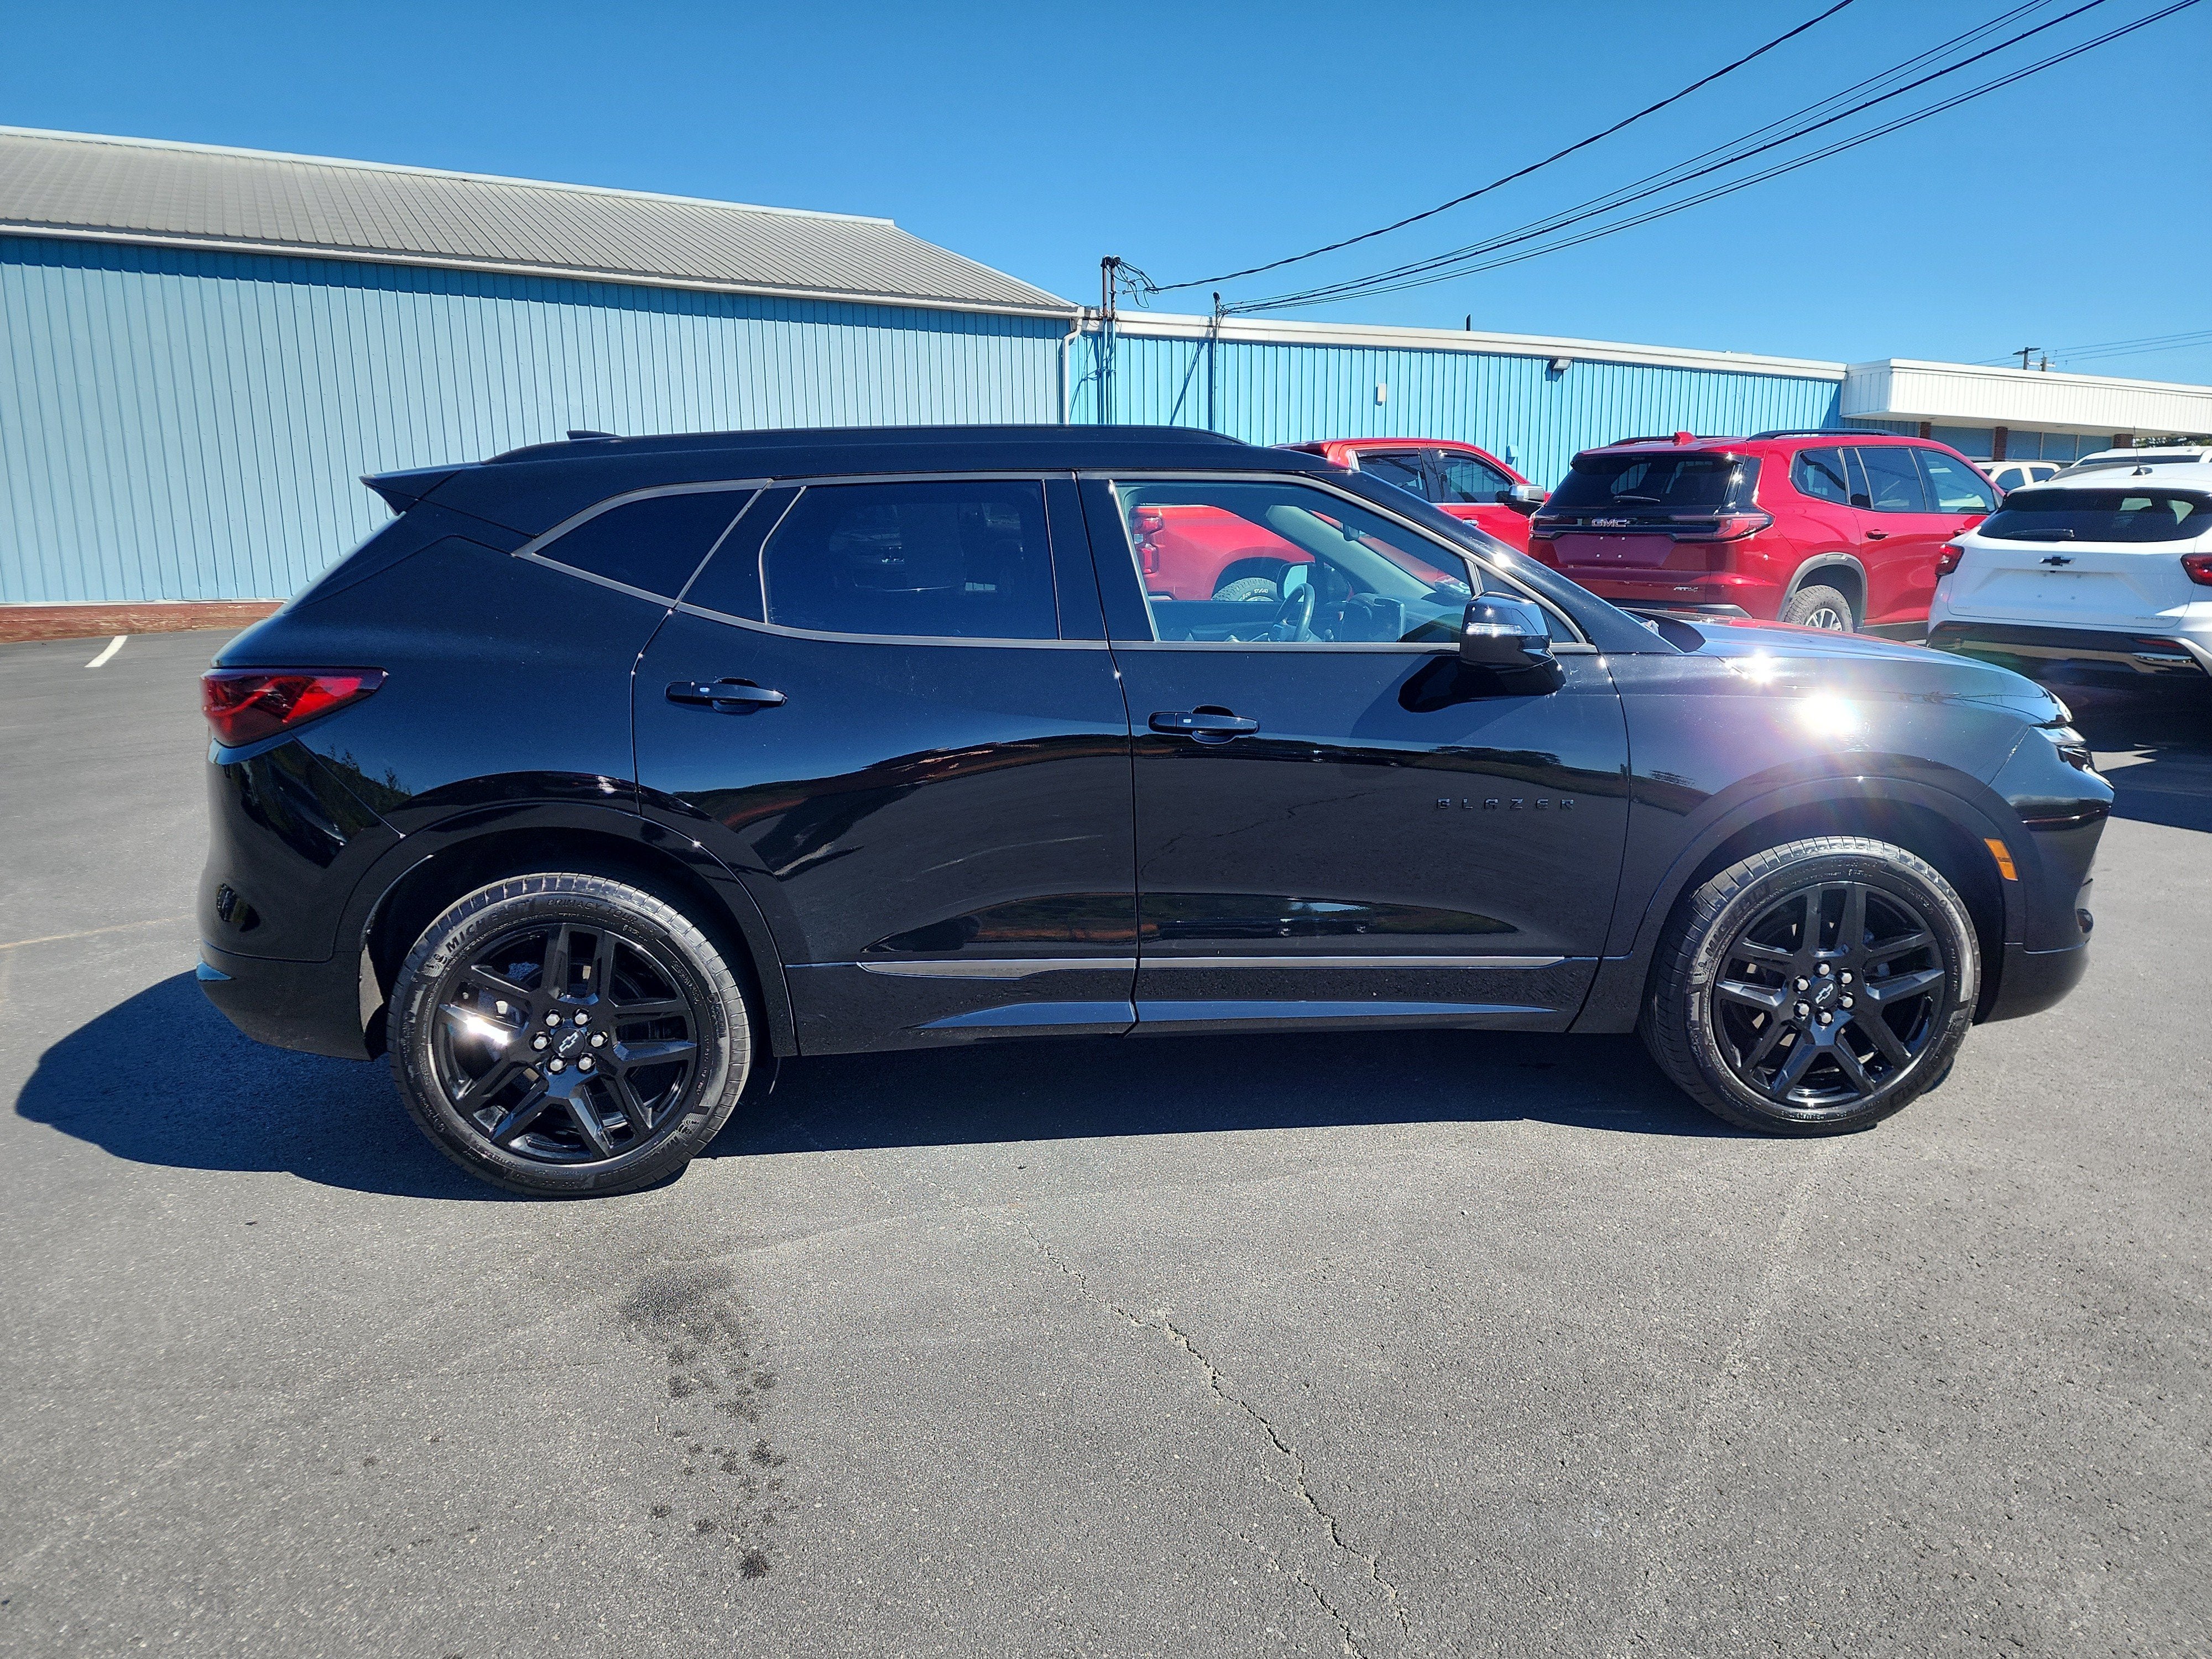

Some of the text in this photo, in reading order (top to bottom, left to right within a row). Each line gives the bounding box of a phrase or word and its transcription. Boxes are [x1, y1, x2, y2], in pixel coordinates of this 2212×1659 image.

[1592, 519, 1627, 528] GMC
[1436, 797, 1575, 810] BLAZER
[607, 905, 639, 925] TOUR
